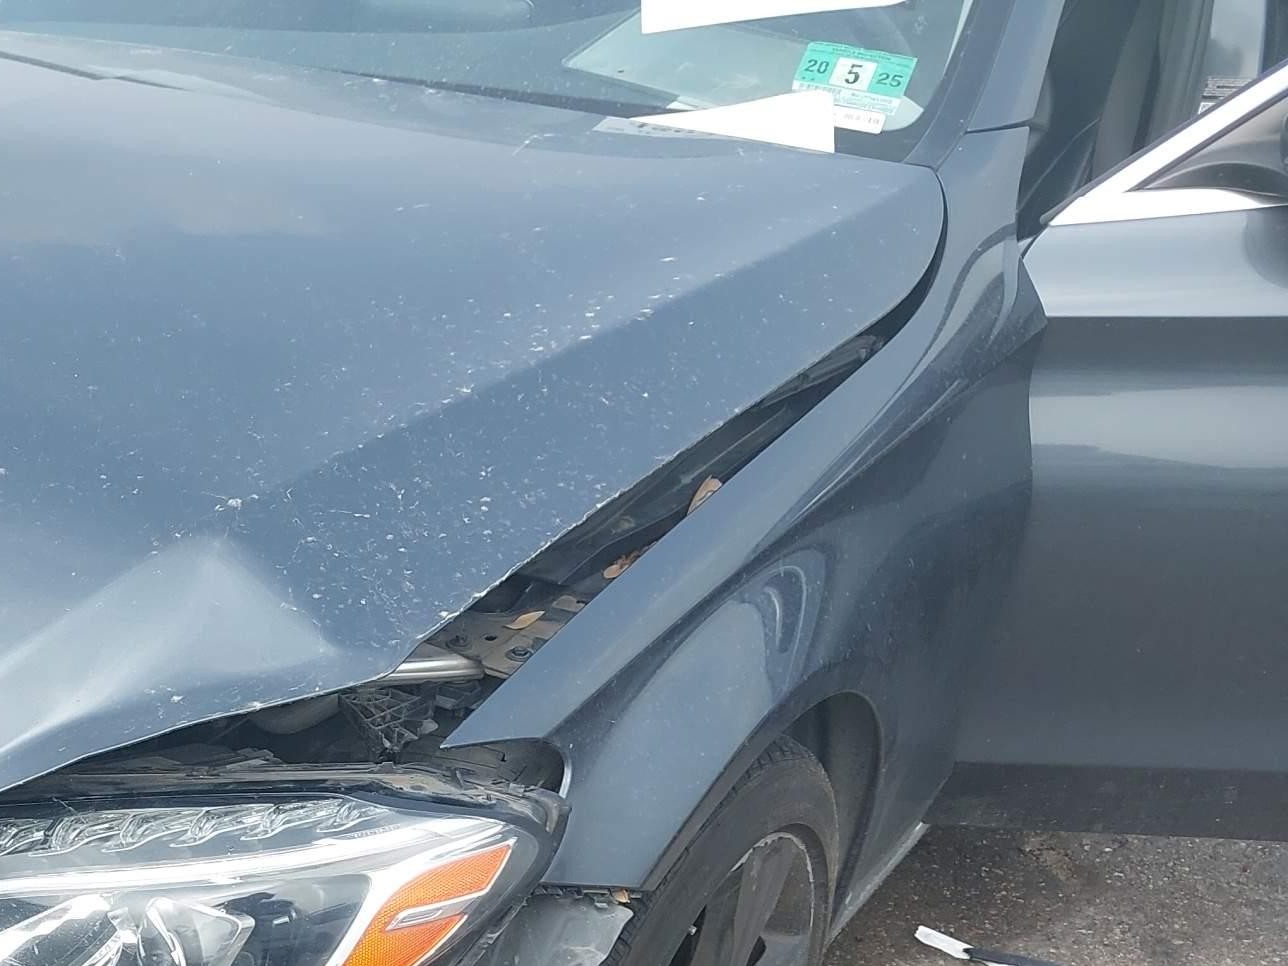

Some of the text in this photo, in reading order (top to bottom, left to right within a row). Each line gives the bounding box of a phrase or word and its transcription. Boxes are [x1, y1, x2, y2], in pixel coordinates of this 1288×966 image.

[804, 58, 904, 88] 20 5 25
